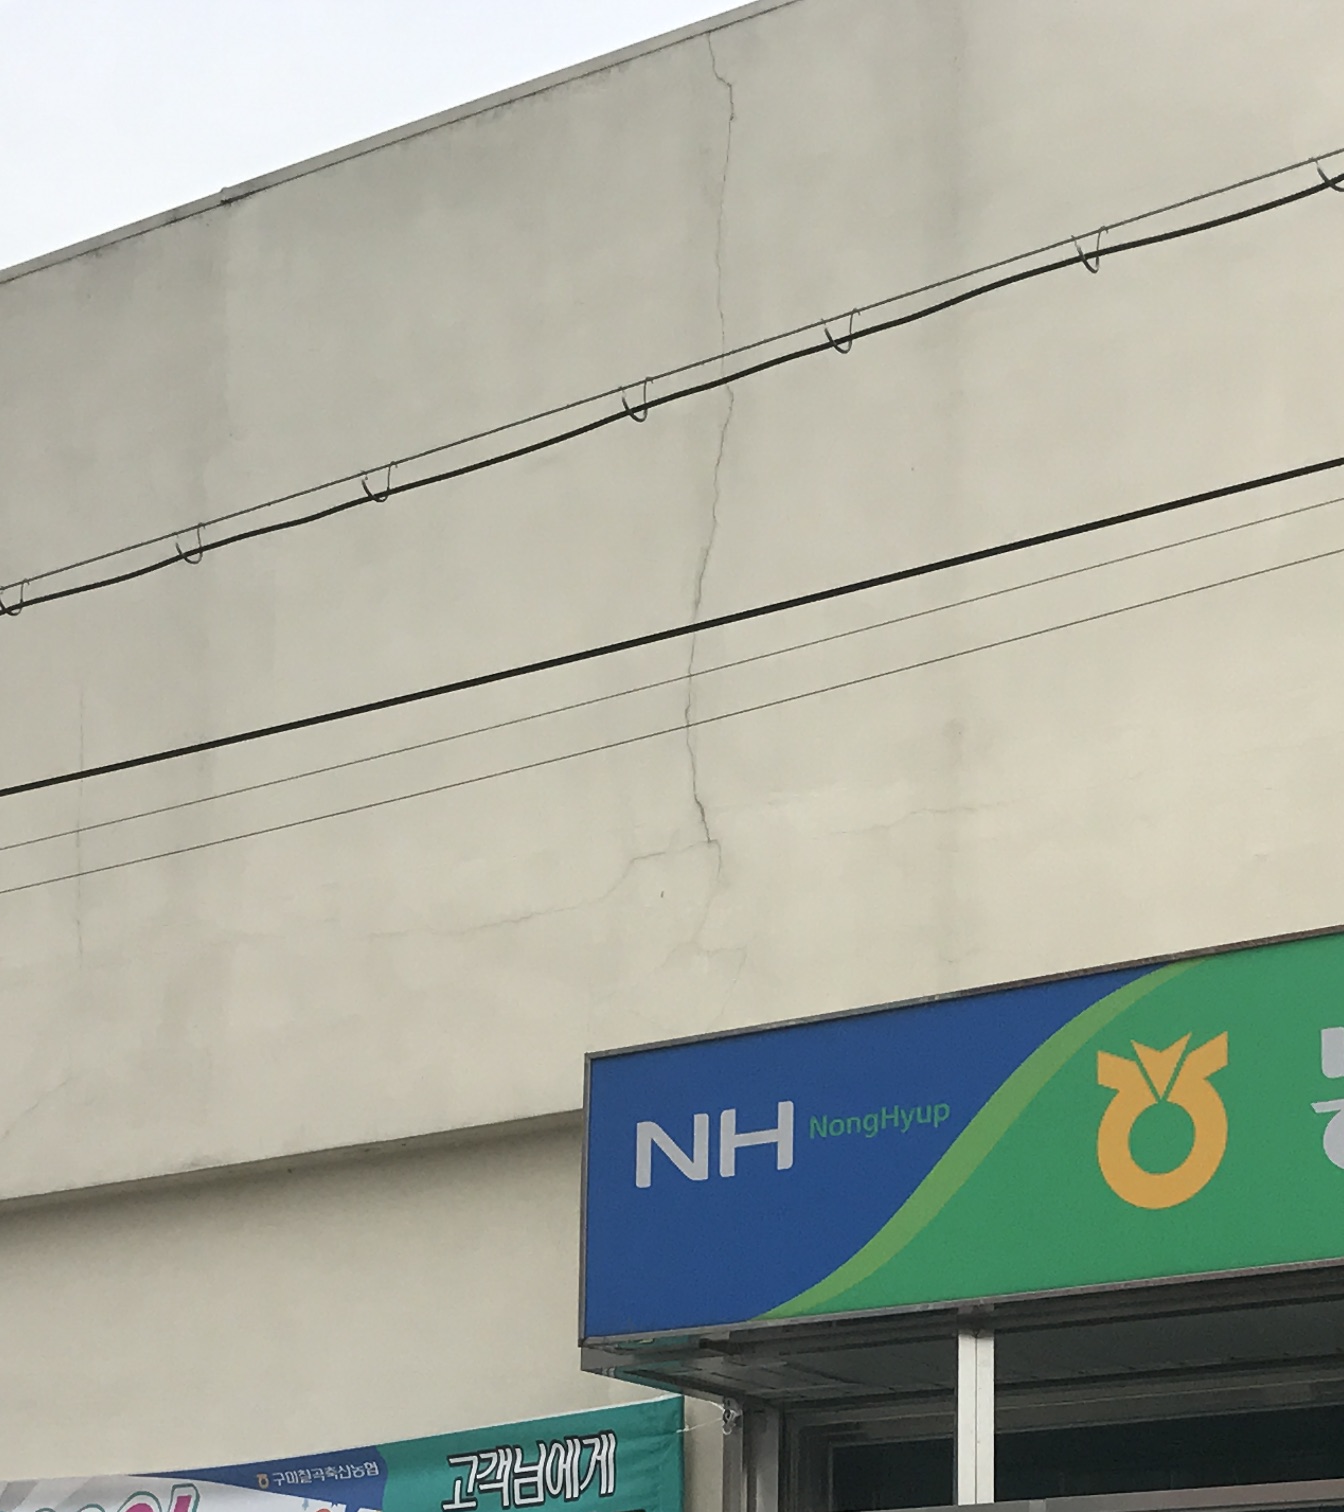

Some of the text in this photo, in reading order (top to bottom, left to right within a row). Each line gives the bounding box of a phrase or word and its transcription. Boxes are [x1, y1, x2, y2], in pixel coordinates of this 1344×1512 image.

[635, 1100, 951, 1189] NH NongHyup
[271, 1460, 381, 1488] 구미칠곡축산농협
[441, 1432, 617, 1511] 고객님에게
